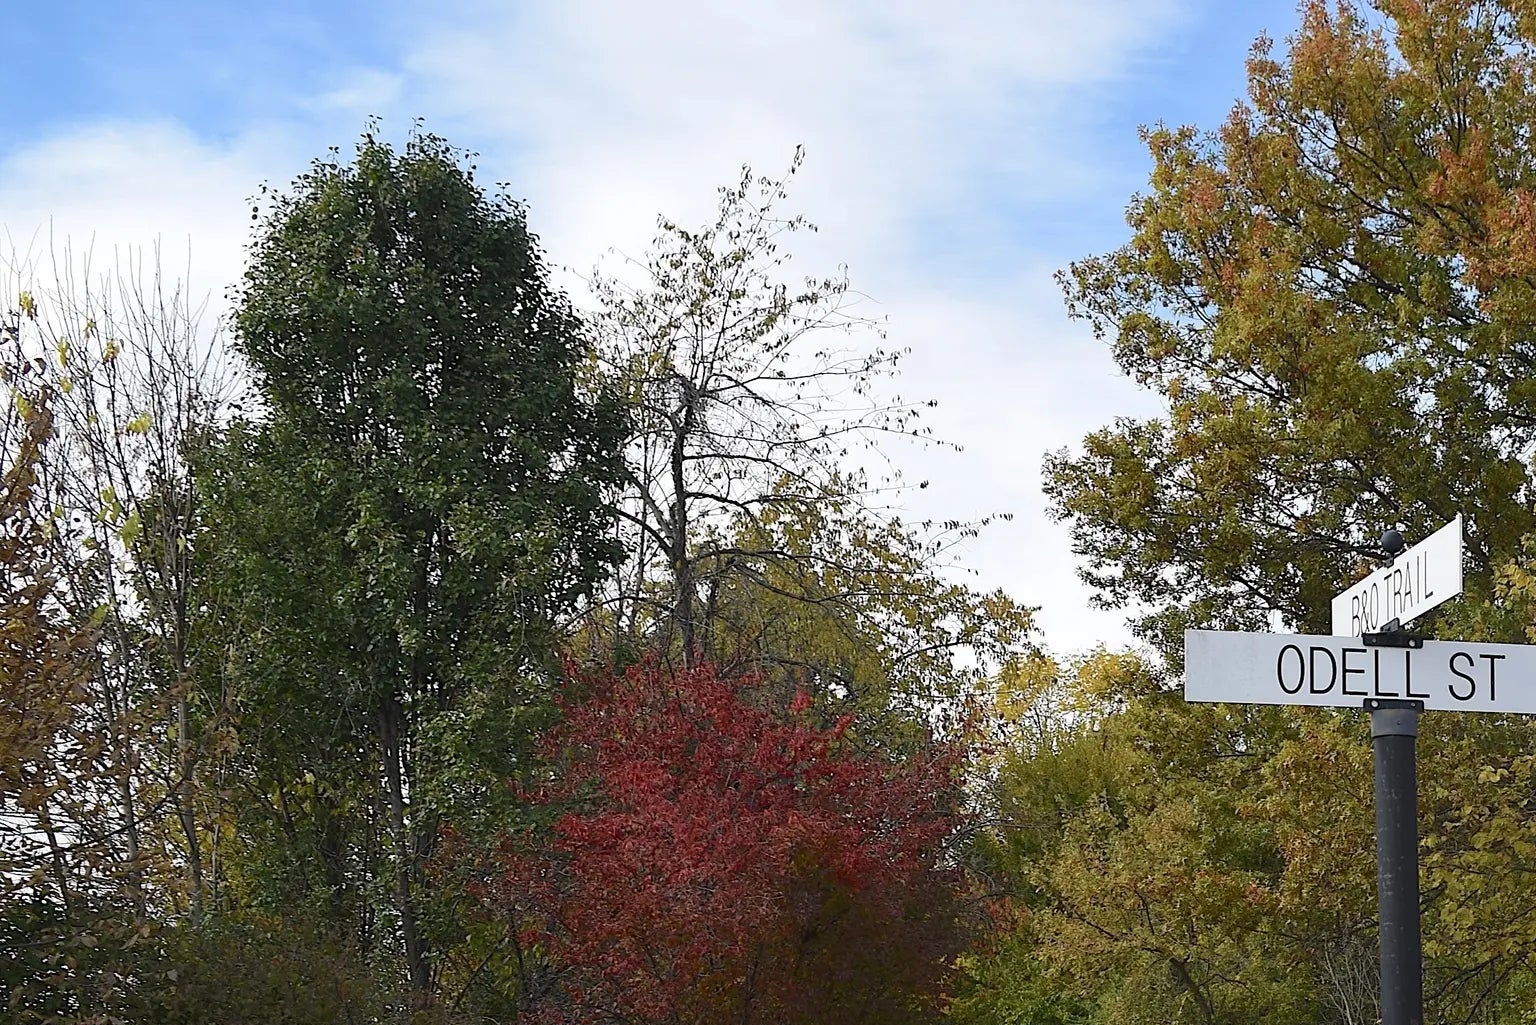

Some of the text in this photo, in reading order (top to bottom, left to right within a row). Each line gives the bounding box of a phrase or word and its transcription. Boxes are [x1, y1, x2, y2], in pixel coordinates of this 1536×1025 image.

[1352, 551, 1434, 638] B&O TRAIL
[1277, 644, 1506, 701] ODELL ST
